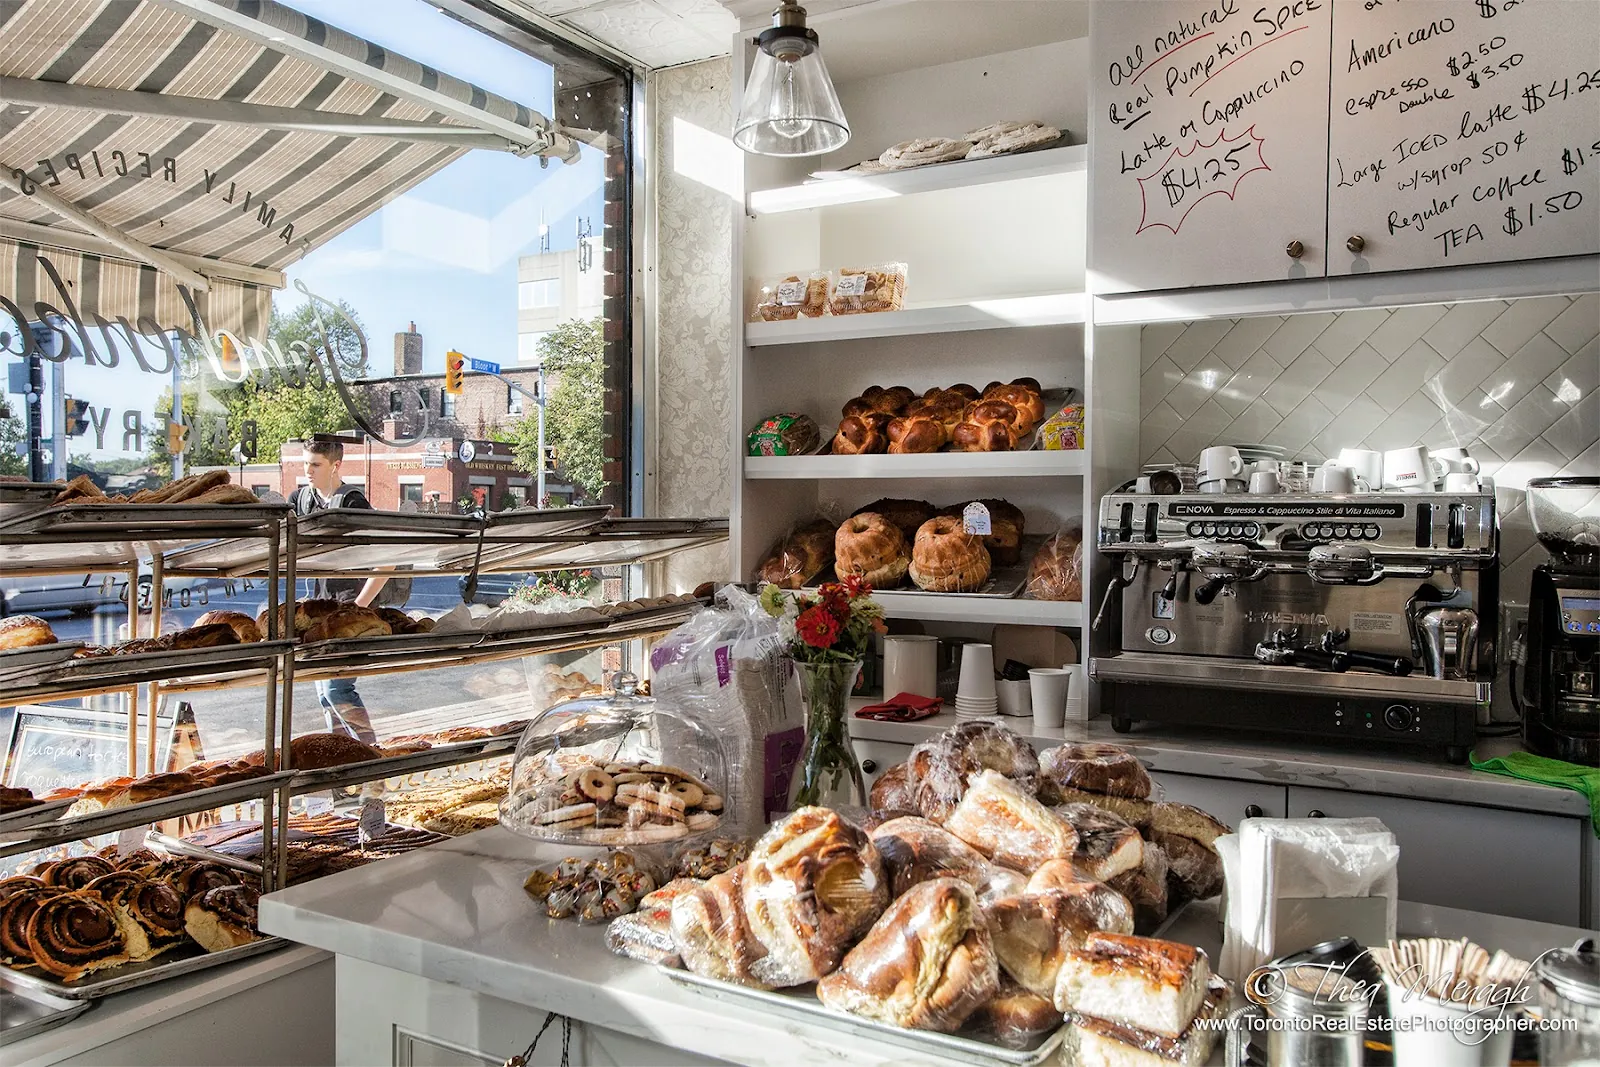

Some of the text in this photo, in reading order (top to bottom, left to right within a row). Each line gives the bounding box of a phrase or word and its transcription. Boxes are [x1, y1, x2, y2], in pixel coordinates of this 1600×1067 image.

[1155, 0, 1240, 53] natural
[1348, 18, 1455, 73] Americano
[1446, 36, 1506, 76] $2.50
[1466, 53, 1523, 89] $3.50
[1161, 142, 1251, 208] $4.25
[1337, 158, 1387, 188] Large
[1388, 194, 1460, 235] Regular
[1434, 190, 1583, 257] TEA $1.50
[1223, 506, 1257, 516] Espresso
[1266, 506, 1315, 516] Cappuccino
[1316, 506, 1334, 515] Stile
[1335, 506, 1344, 515] di
[1345, 507, 1361, 515] Vita
[1363, 507, 1396, 516] Italiano
